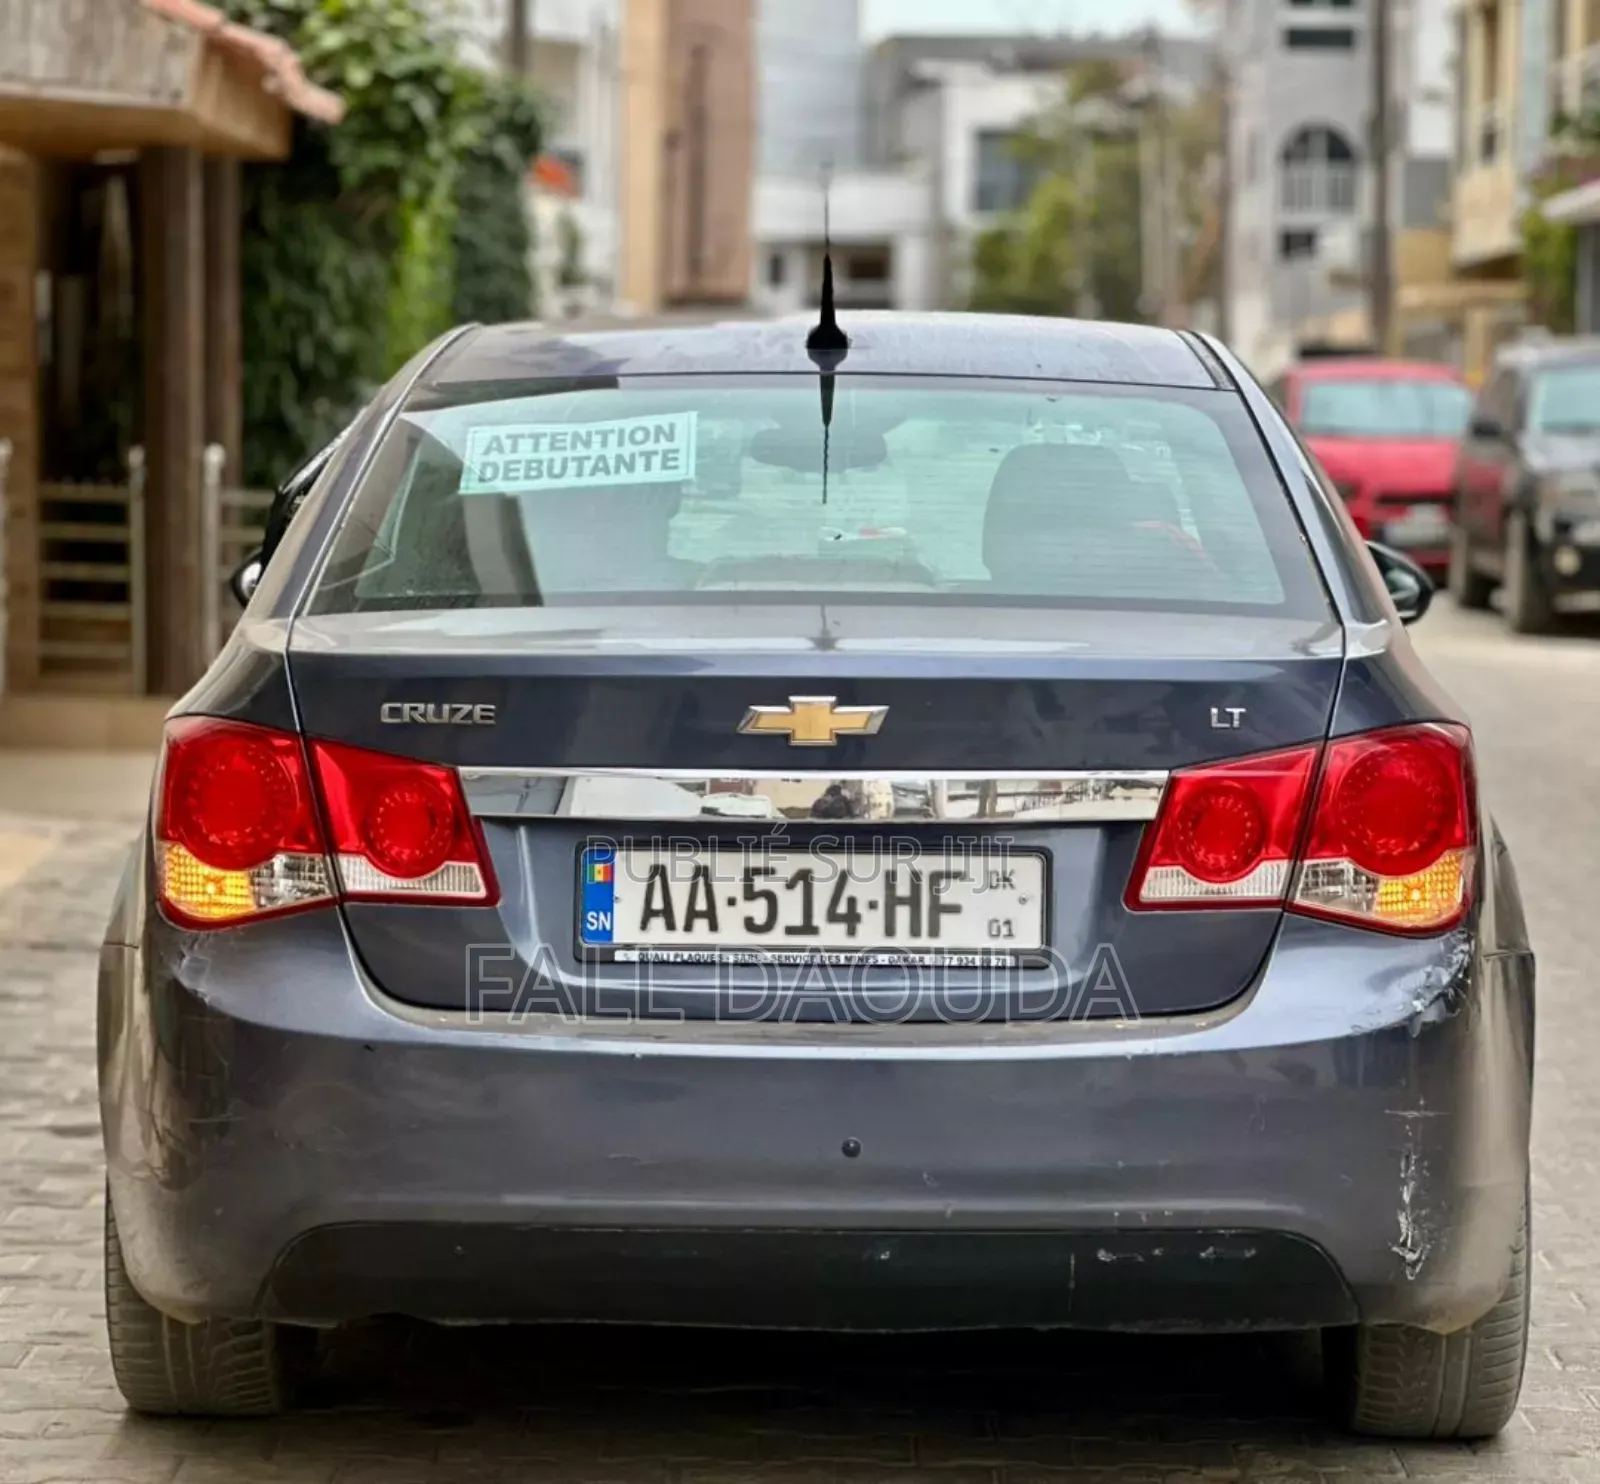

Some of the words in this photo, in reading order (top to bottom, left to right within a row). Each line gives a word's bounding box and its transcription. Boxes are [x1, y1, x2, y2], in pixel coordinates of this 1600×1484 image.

[481, 422, 677, 456] ATTENTION
[477, 448, 681, 484] DEBUTANTE
[380, 703, 497, 725] CRUZE
[1210, 707, 1247, 729] LT
[988, 869, 1017, 890] DK
[586, 911, 611, 931] SN
[987, 918, 1016, 939] 01
